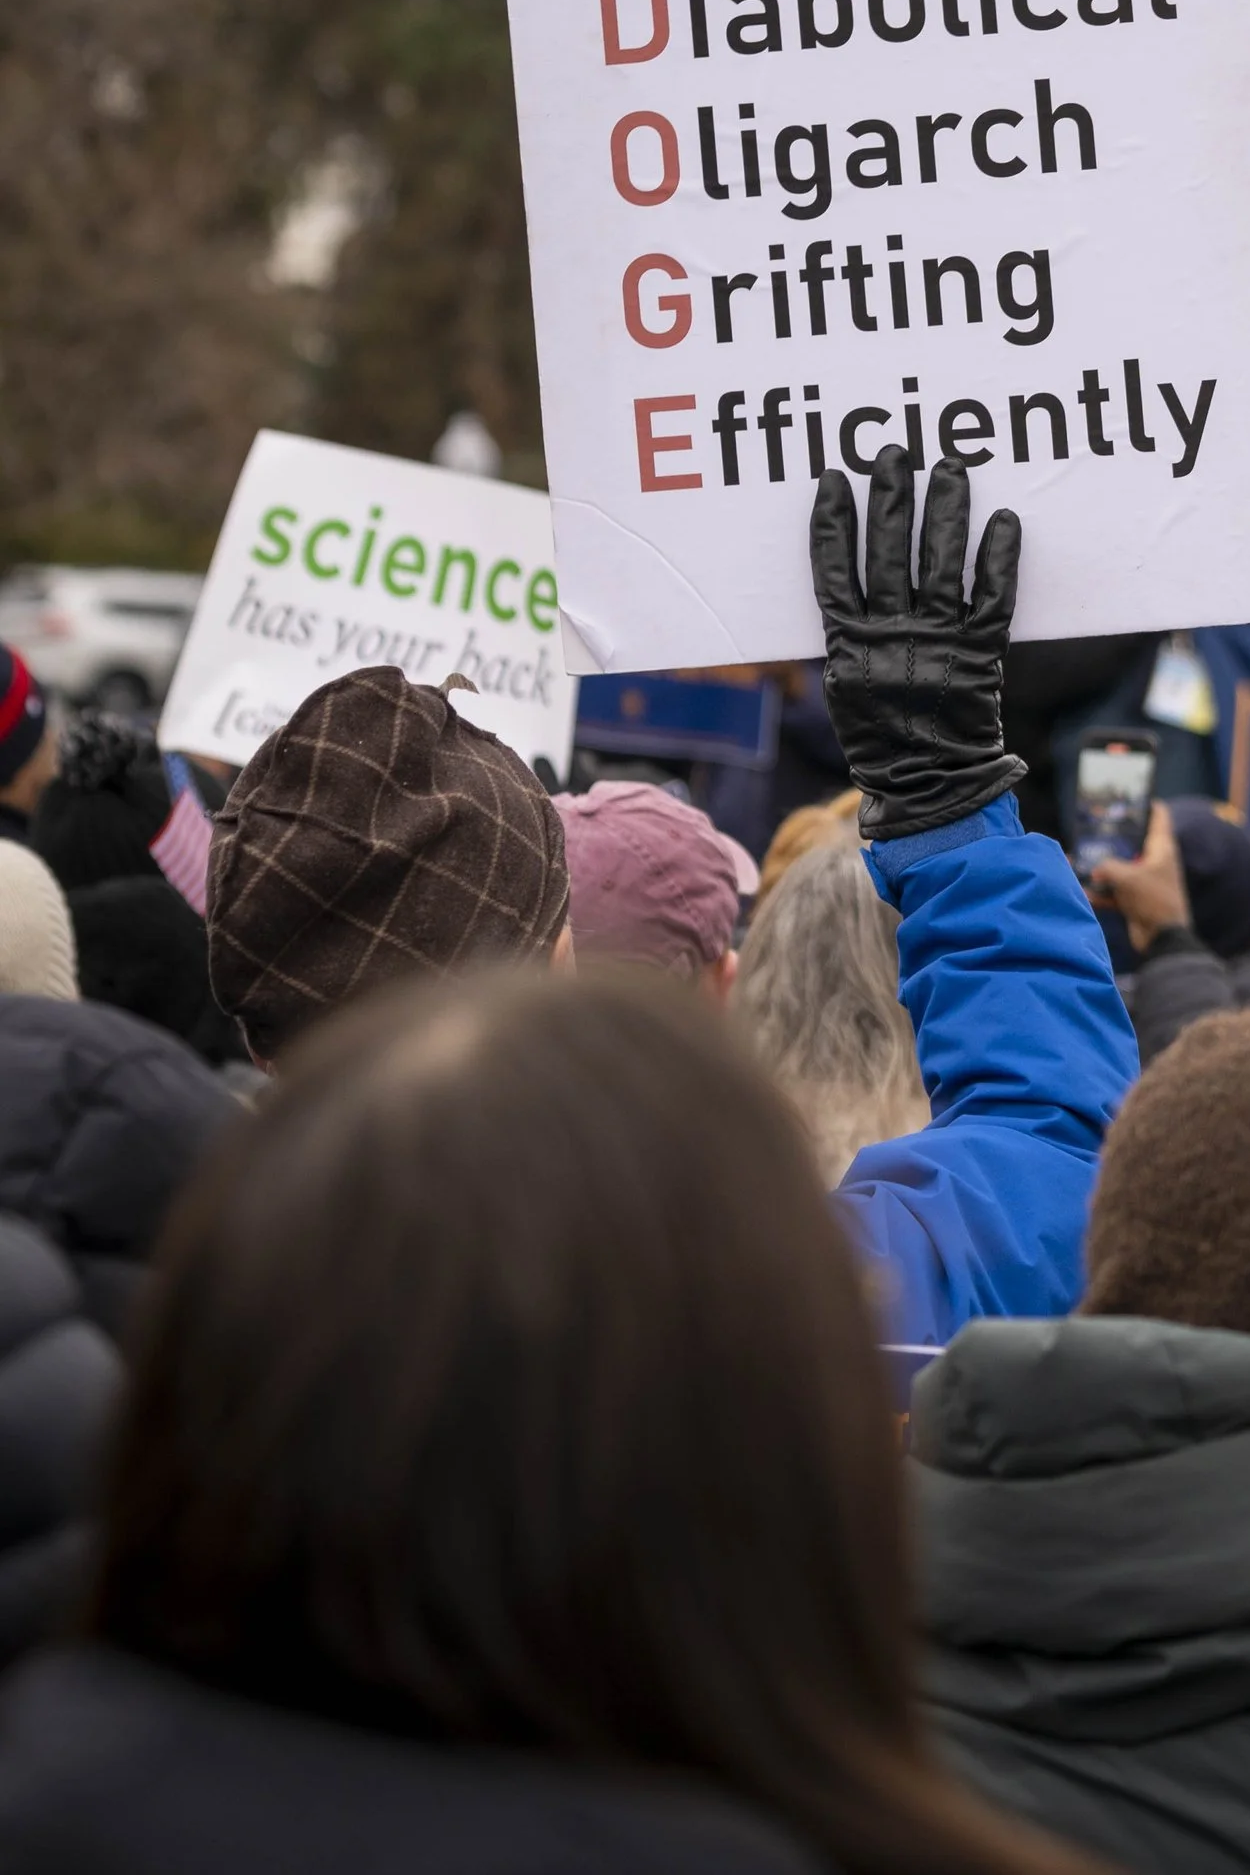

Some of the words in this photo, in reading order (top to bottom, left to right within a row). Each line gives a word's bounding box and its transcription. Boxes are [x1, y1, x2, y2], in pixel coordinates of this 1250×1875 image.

[610, 77, 1097, 220] Oligarch
[622, 233, 1055, 348] Grifting
[633, 358, 1217, 492] Efficiently
[252, 505, 558, 632] science
[226, 577, 320, 647] has
[316, 617, 444, 675] your
[452, 628, 556, 707] back
